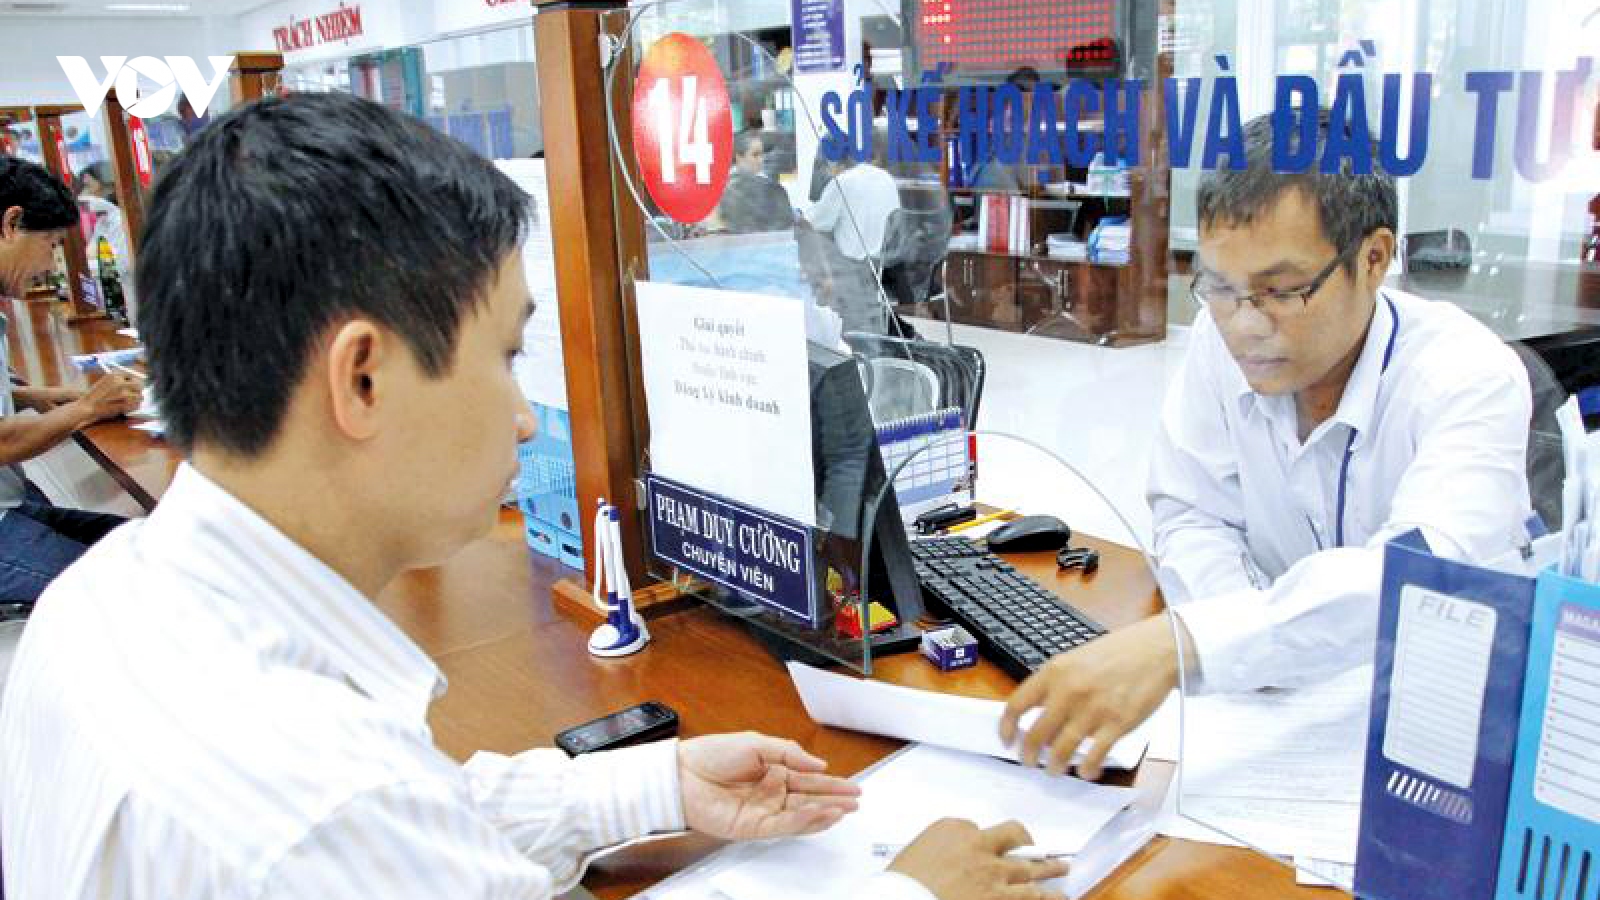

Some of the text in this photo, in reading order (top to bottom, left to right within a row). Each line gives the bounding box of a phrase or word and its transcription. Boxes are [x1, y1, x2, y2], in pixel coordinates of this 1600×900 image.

[647, 75, 714, 184] 14
[819, 39, 1594, 184] SỞ KẾ HOẠCH VÀ ĐẦU TƯ
[655, 493, 801, 575] PHẠM DUY CƯỜNG
[682, 541, 775, 593] CHUYÊN VIÊN
[1417, 594, 1488, 629] FILE
